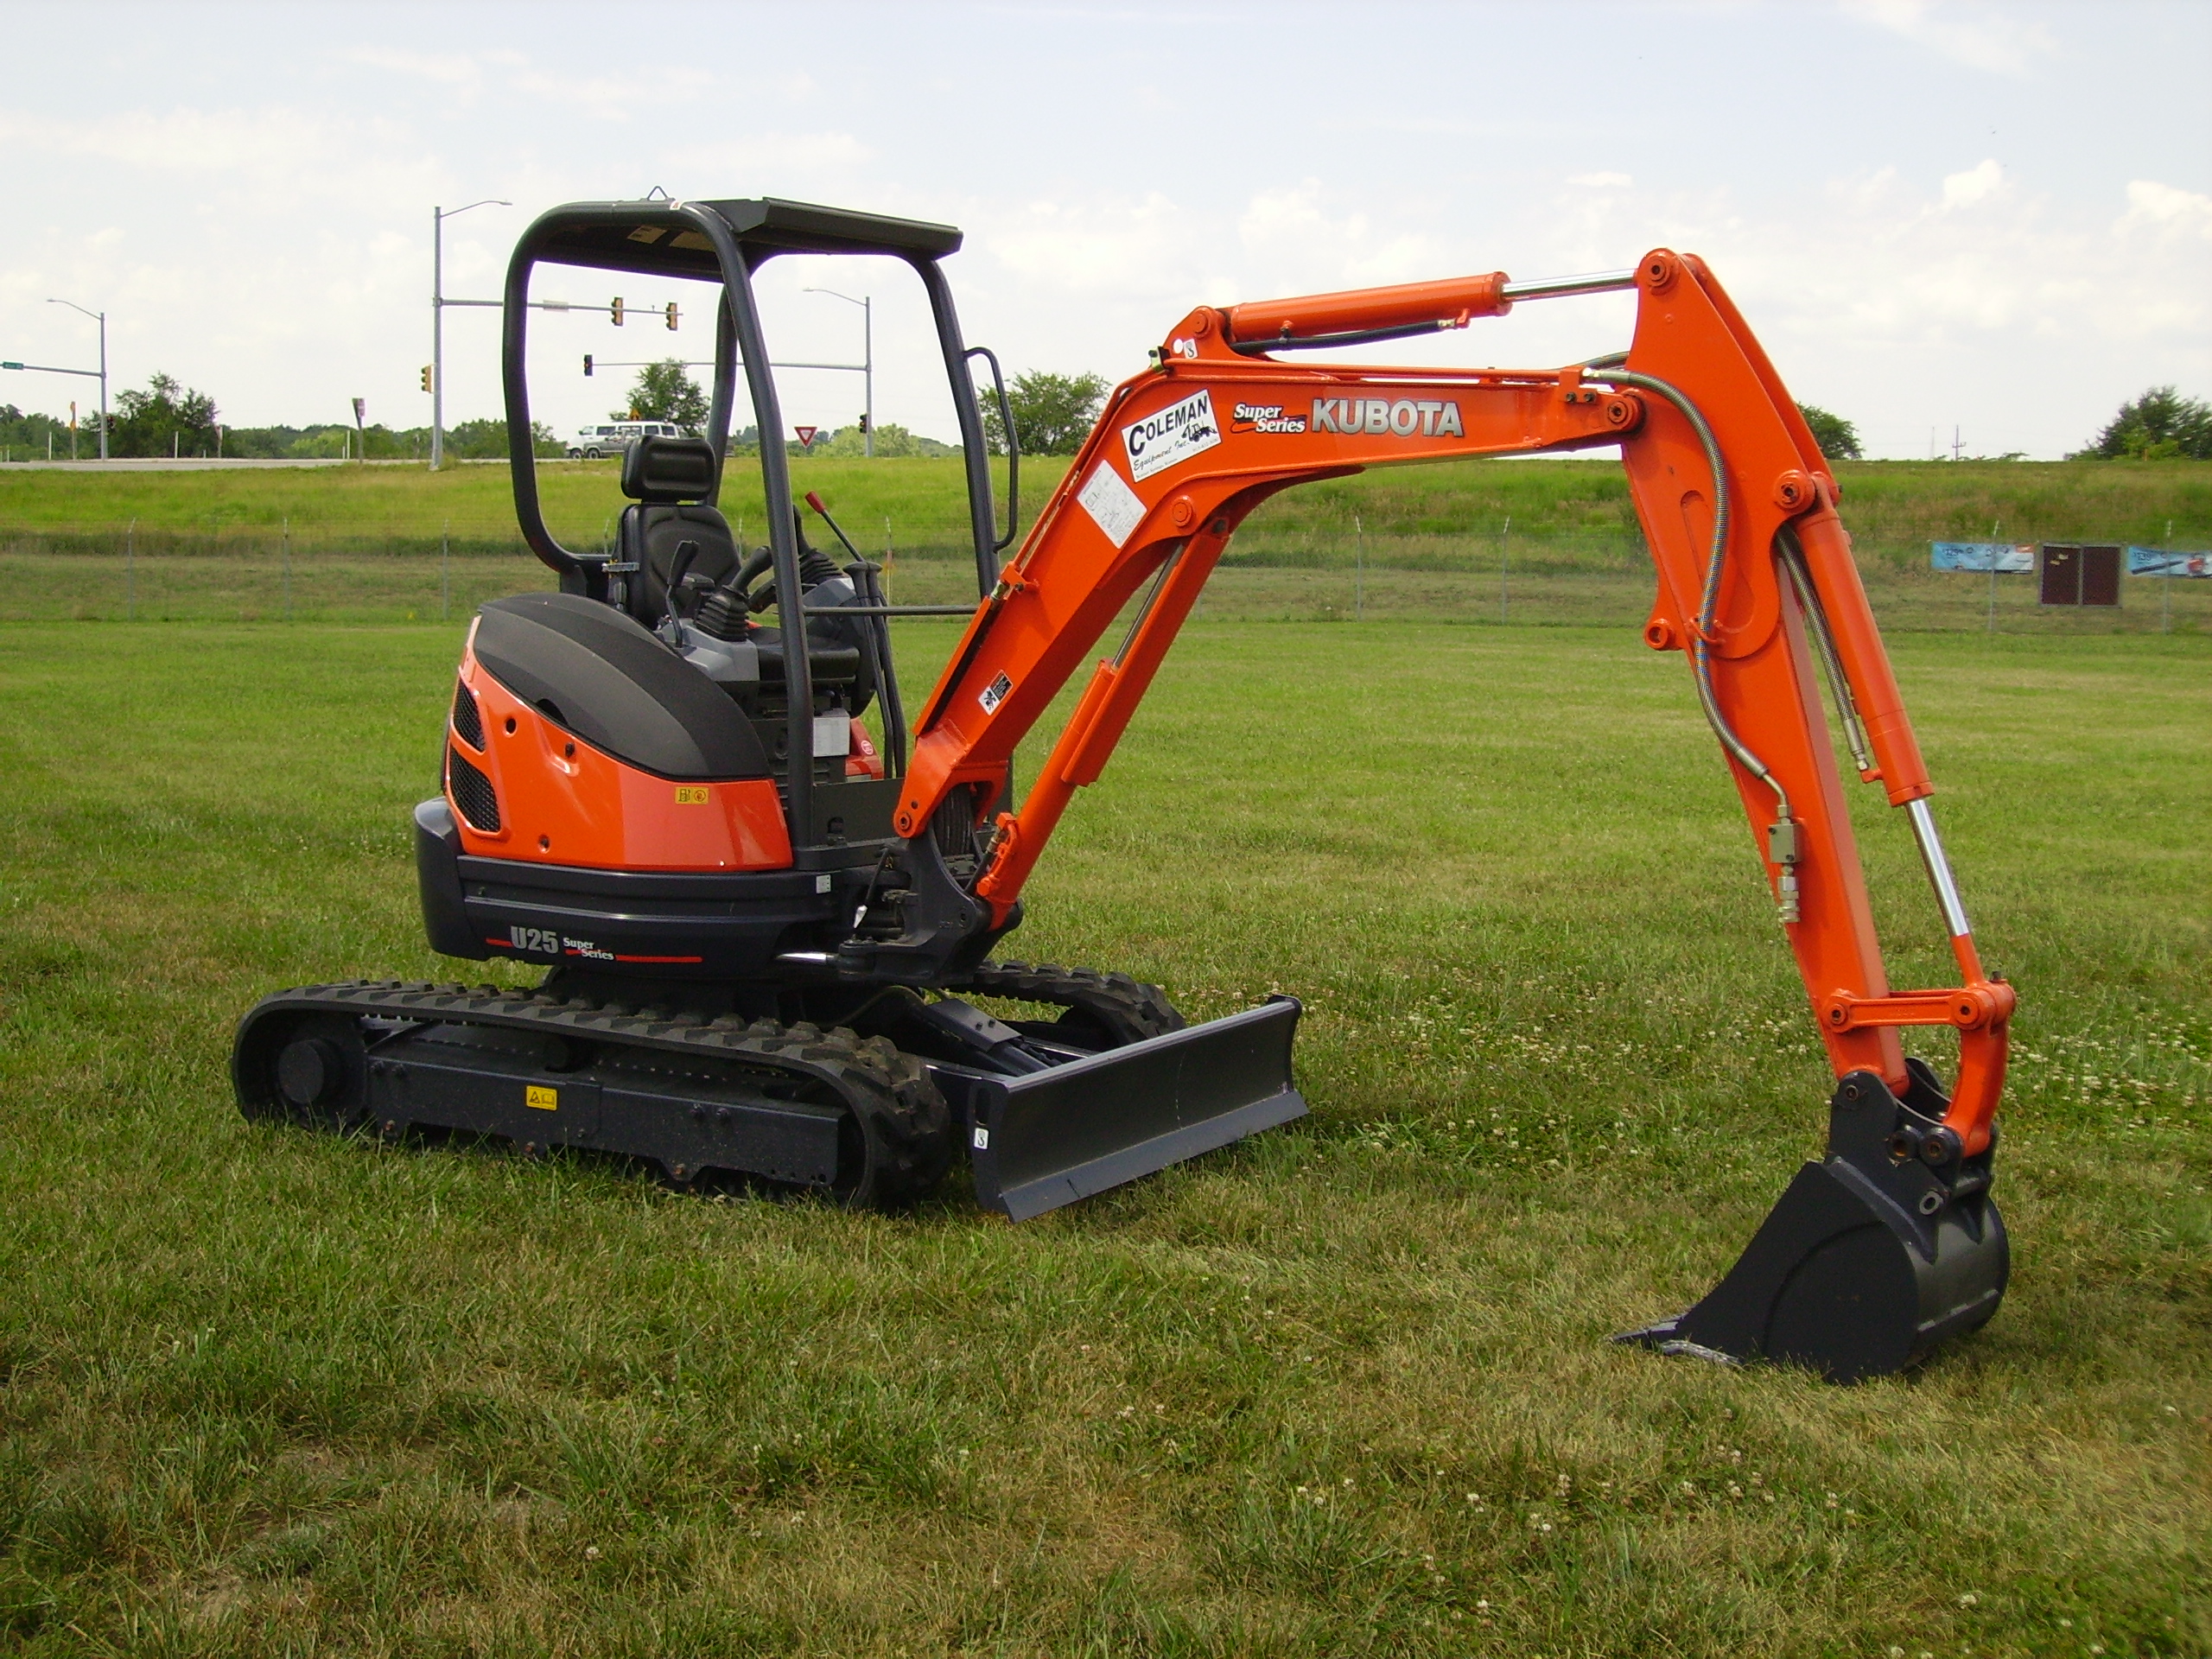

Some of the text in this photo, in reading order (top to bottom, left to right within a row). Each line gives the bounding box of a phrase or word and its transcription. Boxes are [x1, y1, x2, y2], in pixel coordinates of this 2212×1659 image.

[1233, 403, 1283, 423] Super
[1255, 416, 1306, 433] Series
[1311, 398, 1465, 437] KUBOTA
[1128, 395, 1208, 457] COLEMAN
[1134, 446, 1173, 472] Equipment
[510, 925, 560, 954] U25
[563, 937, 594, 950] Super
[581, 949, 615, 961] Series
